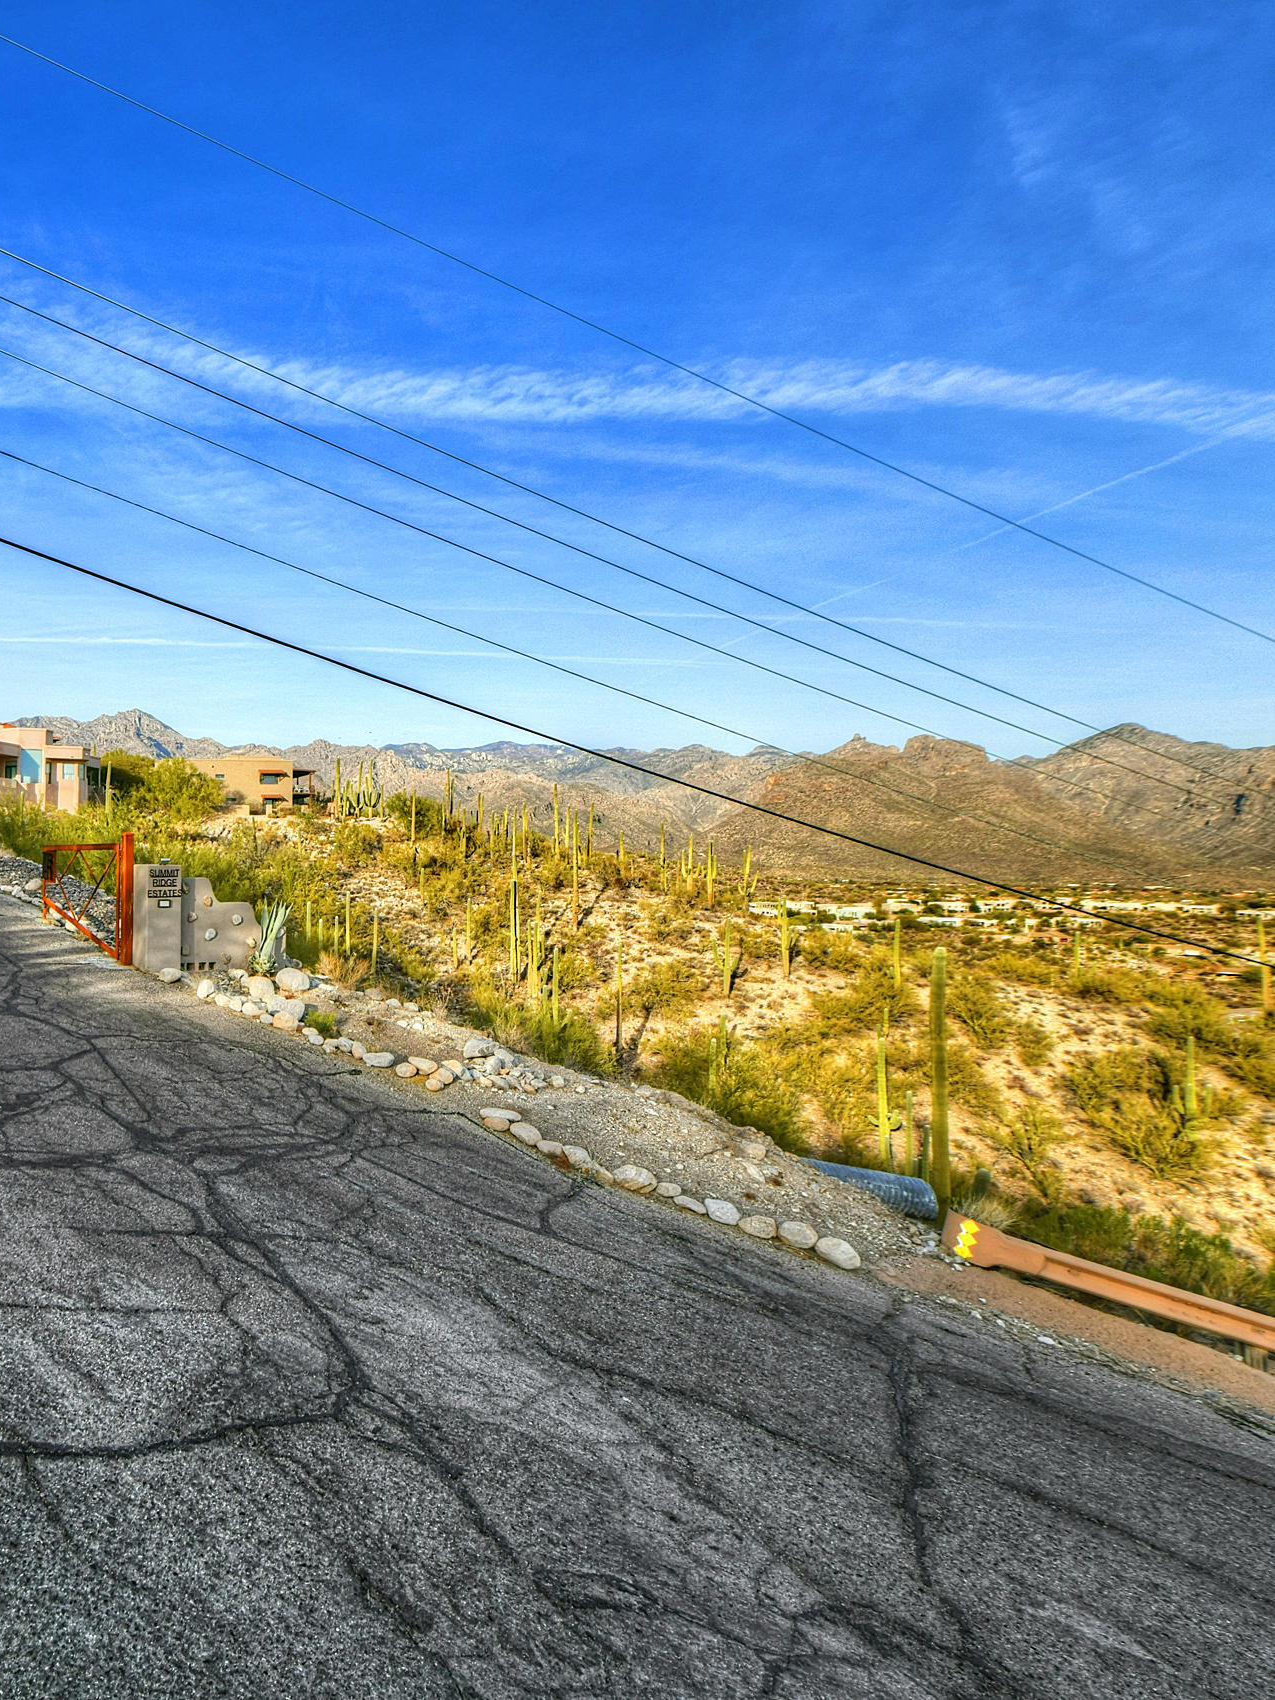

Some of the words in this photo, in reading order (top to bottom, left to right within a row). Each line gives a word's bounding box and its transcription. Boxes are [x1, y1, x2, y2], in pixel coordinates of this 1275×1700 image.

[149, 869, 180, 878] SUMMIT
[152, 879, 177, 887] RIDGE
[148, 889, 182, 898] ESTATES
